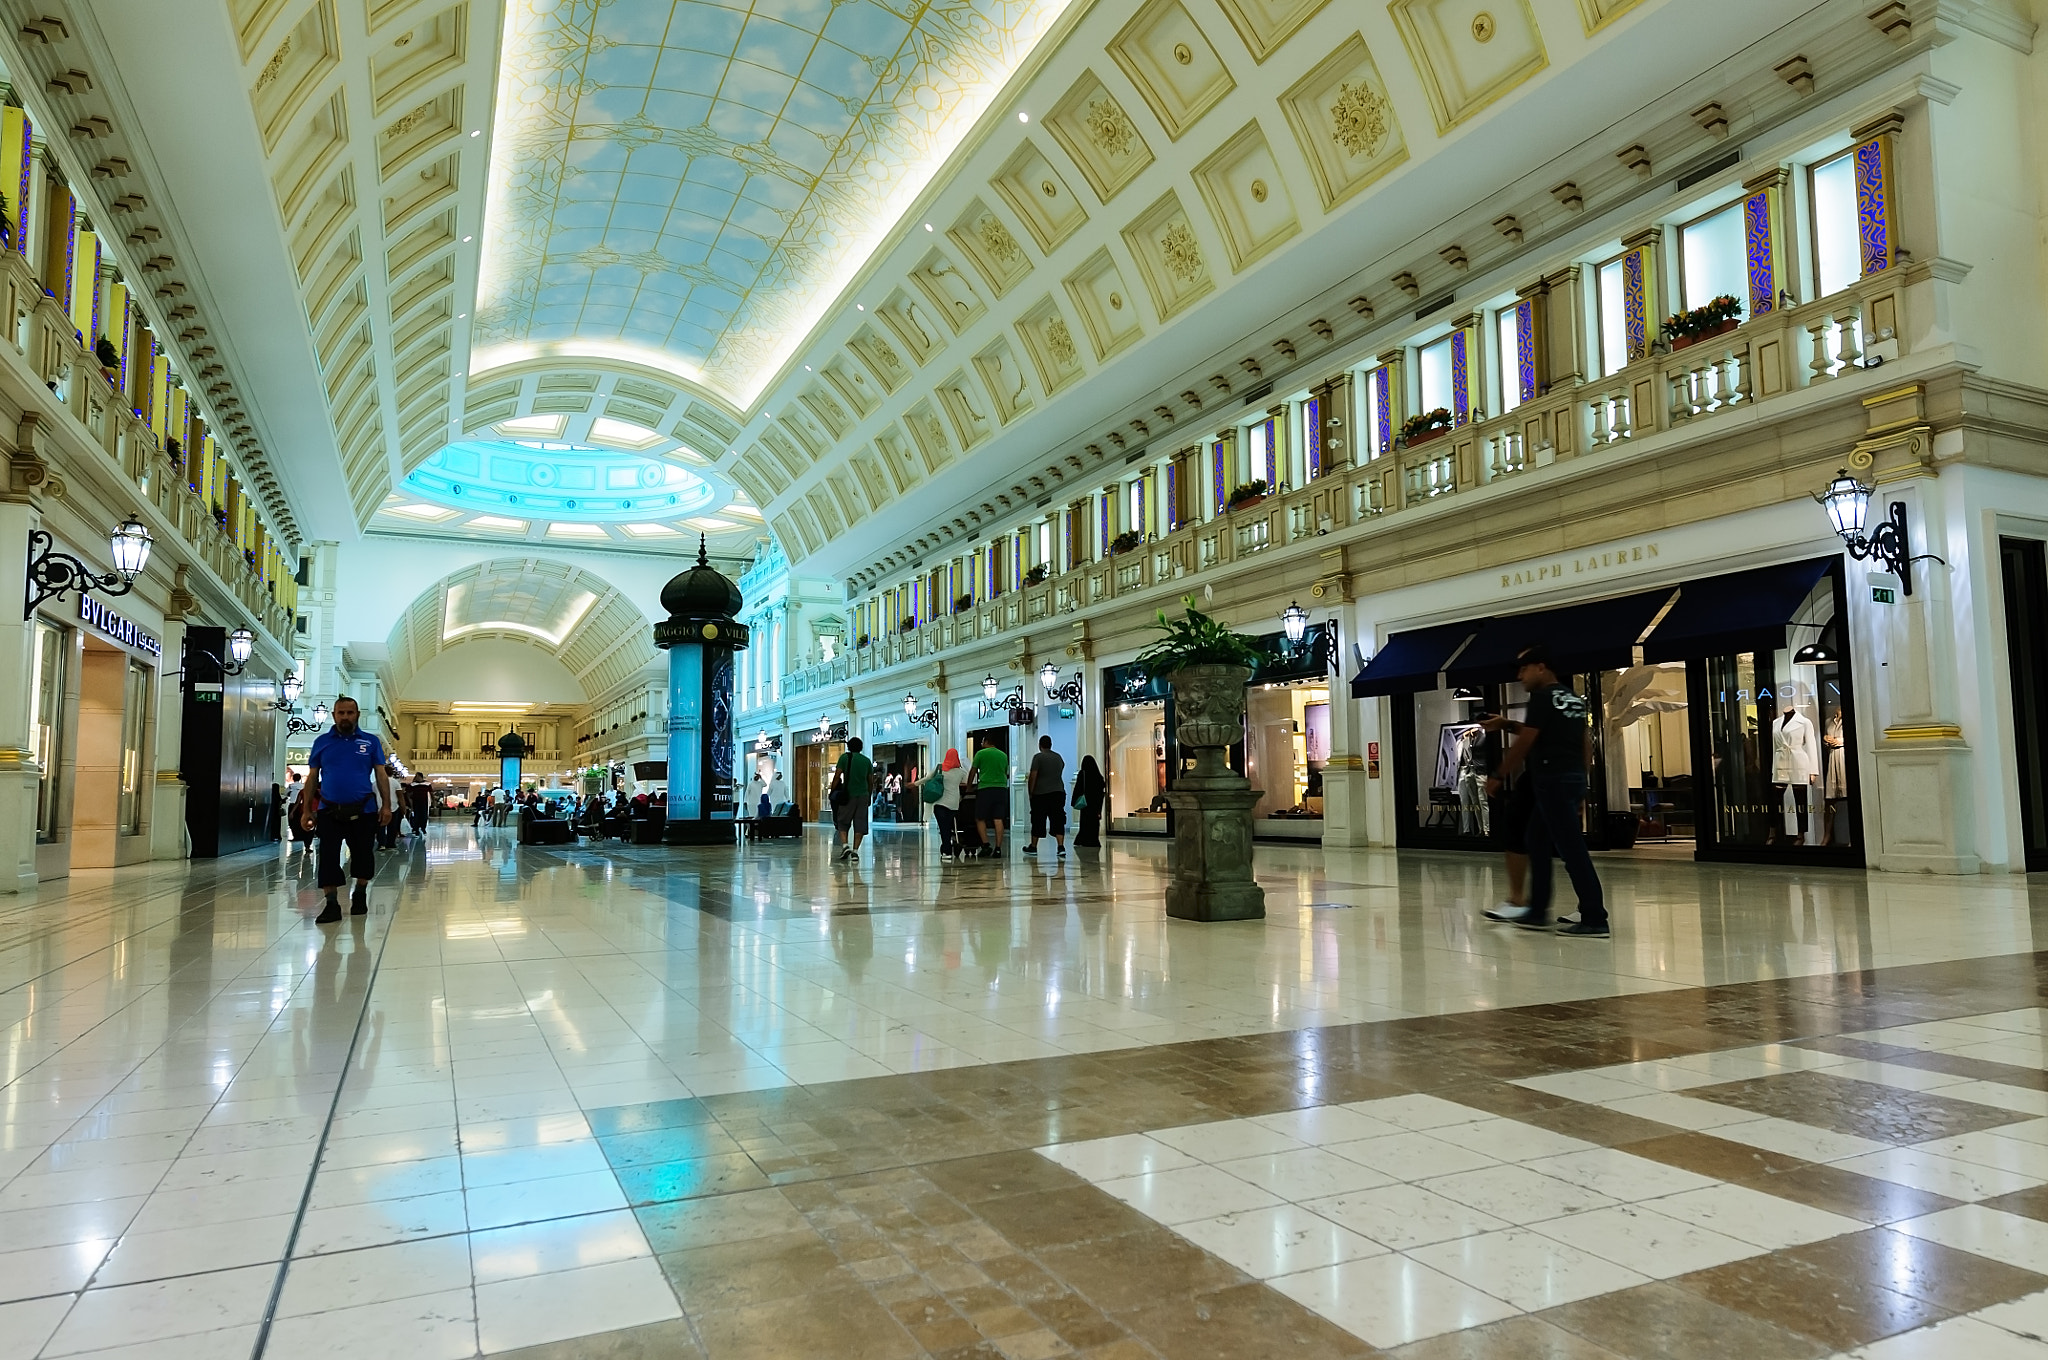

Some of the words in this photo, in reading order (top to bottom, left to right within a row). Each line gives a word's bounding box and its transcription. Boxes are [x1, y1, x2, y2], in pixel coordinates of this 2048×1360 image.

[1501, 564, 1562, 588] RALPH
[1574, 543, 1659, 573] LAUREN
[81, 593, 138, 647] BVLGARI
[359, 744, 367, 753] 5
[1723, 804, 1769, 814] RALPH
